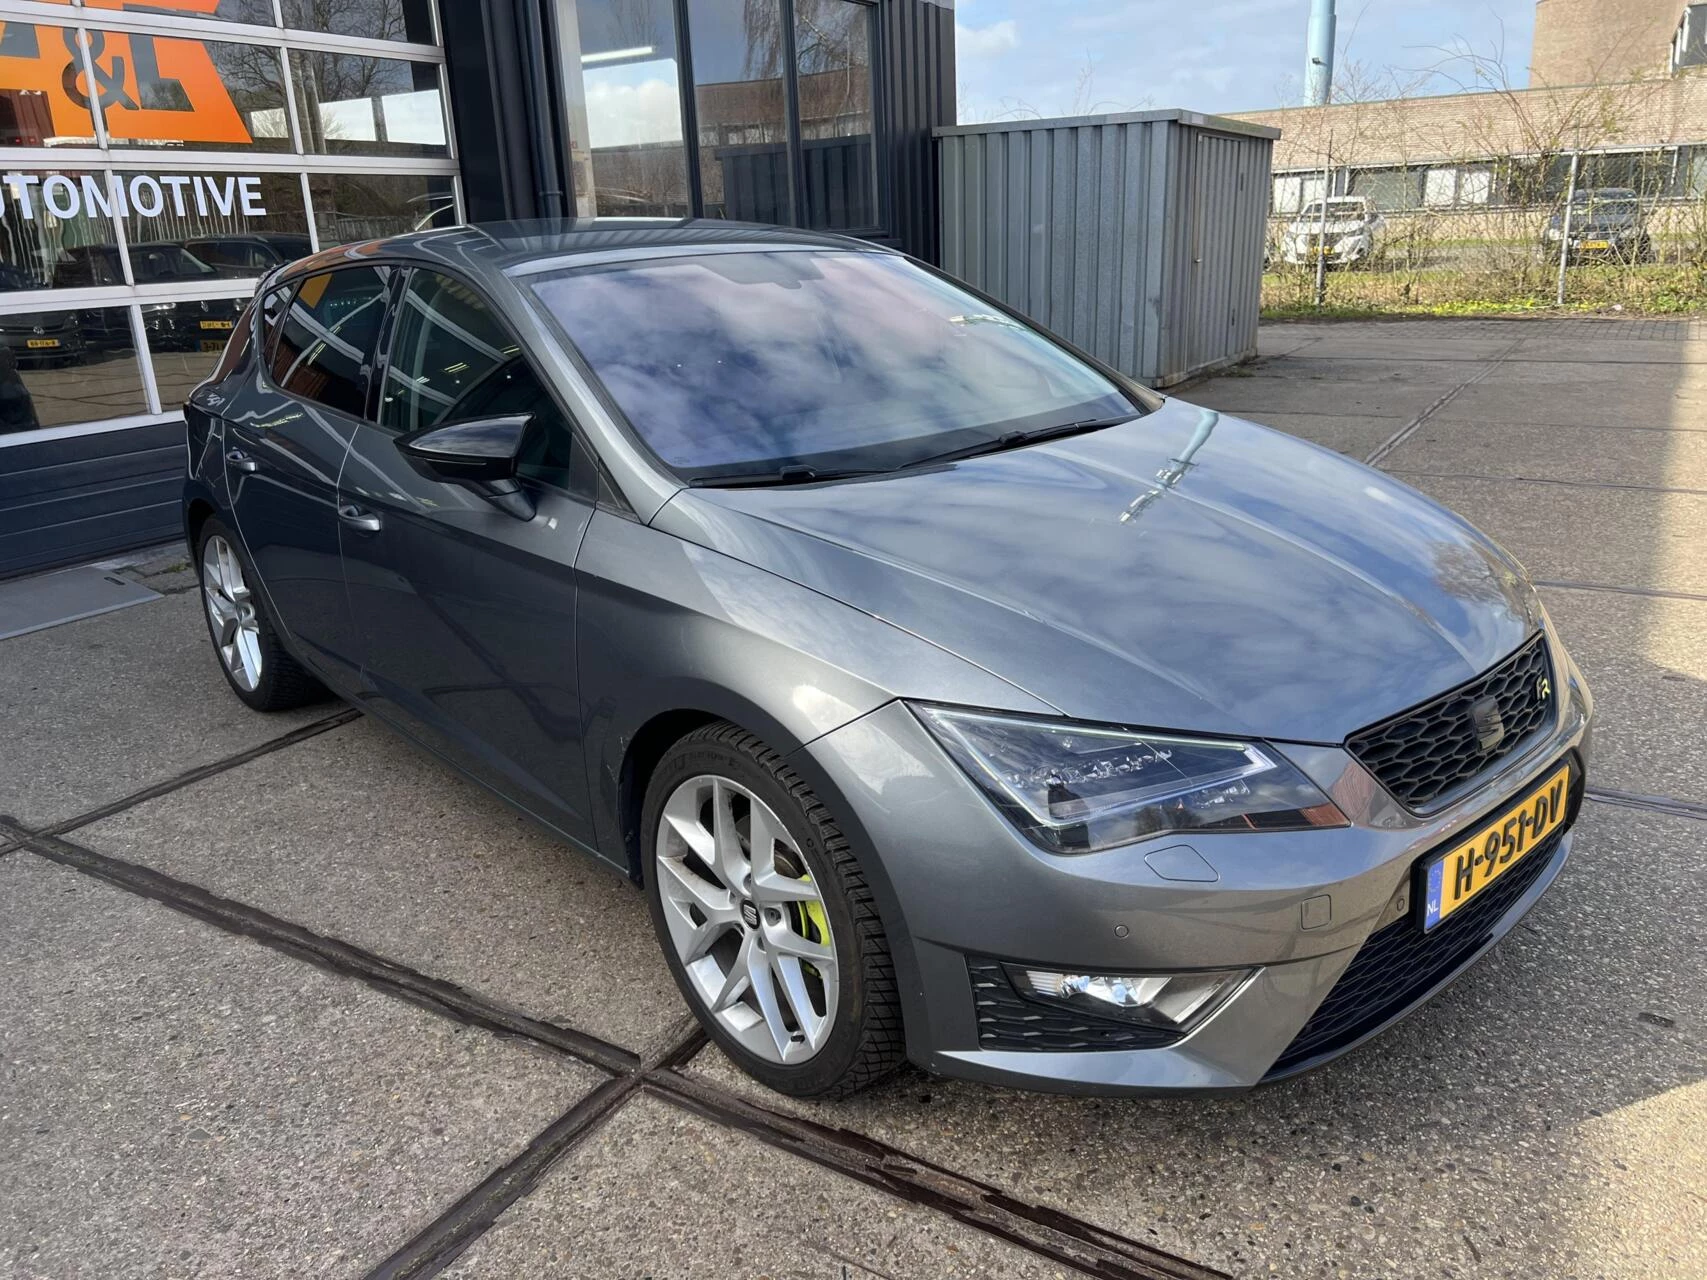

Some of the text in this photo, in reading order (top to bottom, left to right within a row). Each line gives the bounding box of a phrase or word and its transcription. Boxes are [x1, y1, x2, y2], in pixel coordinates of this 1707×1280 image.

[0, 175, 267, 219] TOMOTIVE
[1454, 779, 1563, 900] H-951-DV
[1426, 899, 1438, 917] NL
